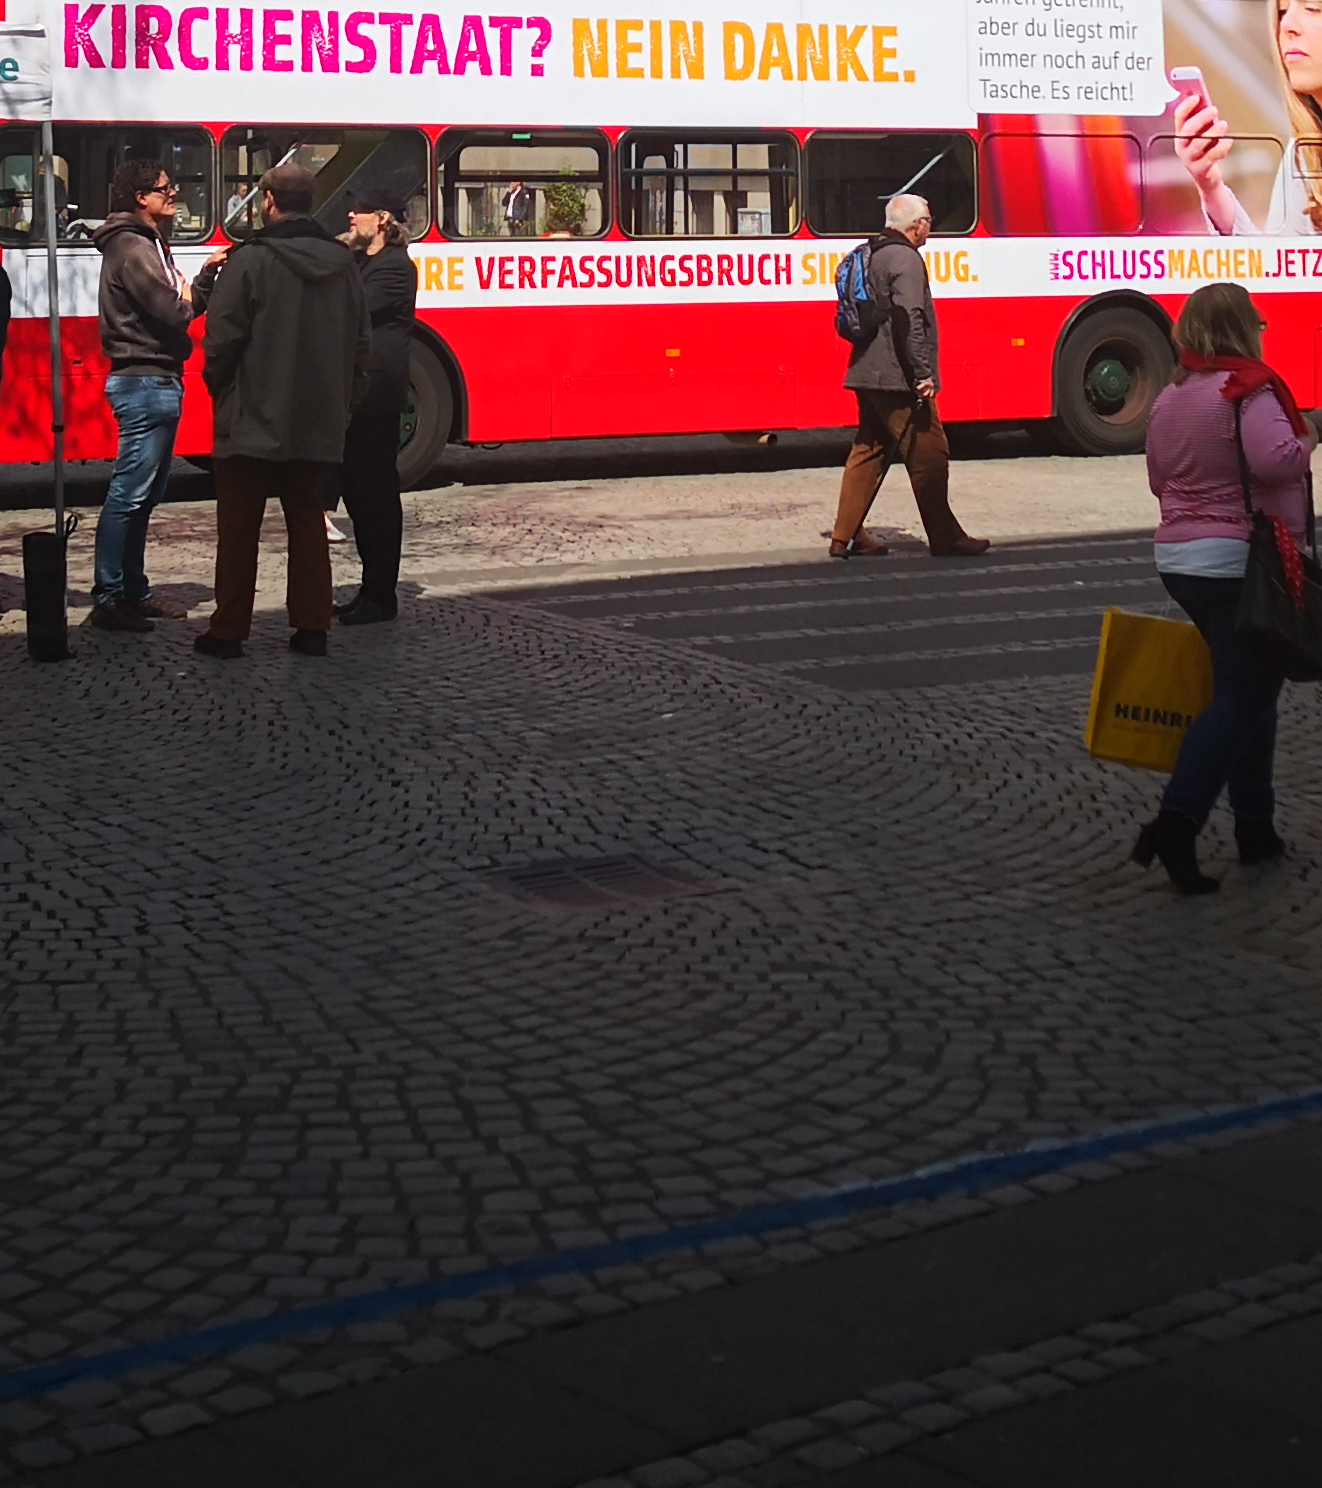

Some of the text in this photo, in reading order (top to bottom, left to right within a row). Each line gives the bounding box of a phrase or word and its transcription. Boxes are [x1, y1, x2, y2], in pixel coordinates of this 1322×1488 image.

[64, 3, 916, 83] KIRCHENSTAAT? NEIN DANKE.
[978, 17, 1138, 43] aber du liegst mir
[979, 47, 1152, 71] immer noch auf der
[979, 79, 1134, 101] Tasche. Es reicht!
[475, 254, 792, 290] VERFASSUNGSBRUCH
